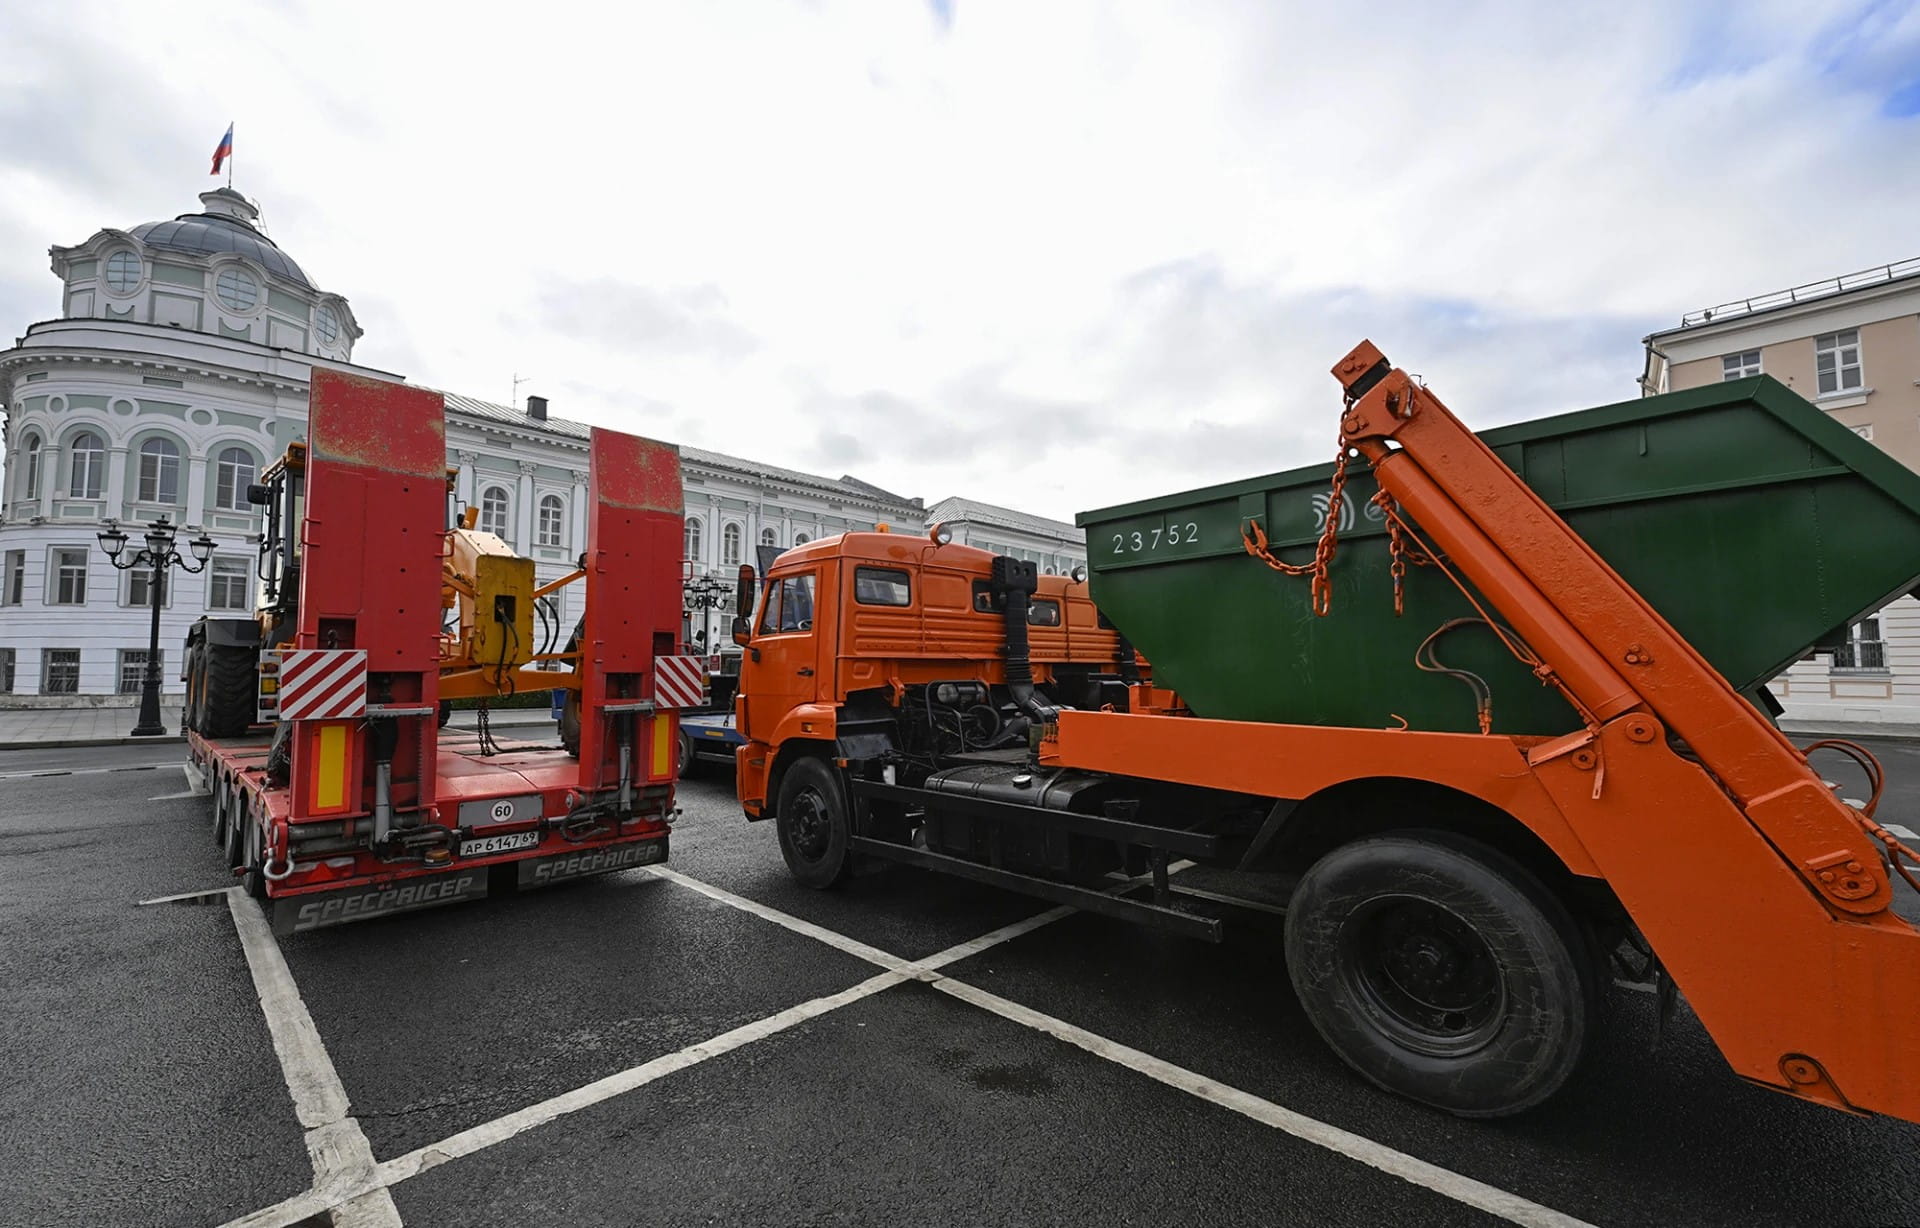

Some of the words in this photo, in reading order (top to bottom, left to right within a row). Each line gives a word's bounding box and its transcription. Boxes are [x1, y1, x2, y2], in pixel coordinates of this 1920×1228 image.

[1112, 522, 1199, 554] 23752
[494, 805, 512, 817] 60
[485, 835, 520, 851] 6147
[522, 831, 536, 843] 69
[534, 844, 659, 881] SPECPRICEP
[294, 876, 473, 931] SPECPRICEP
